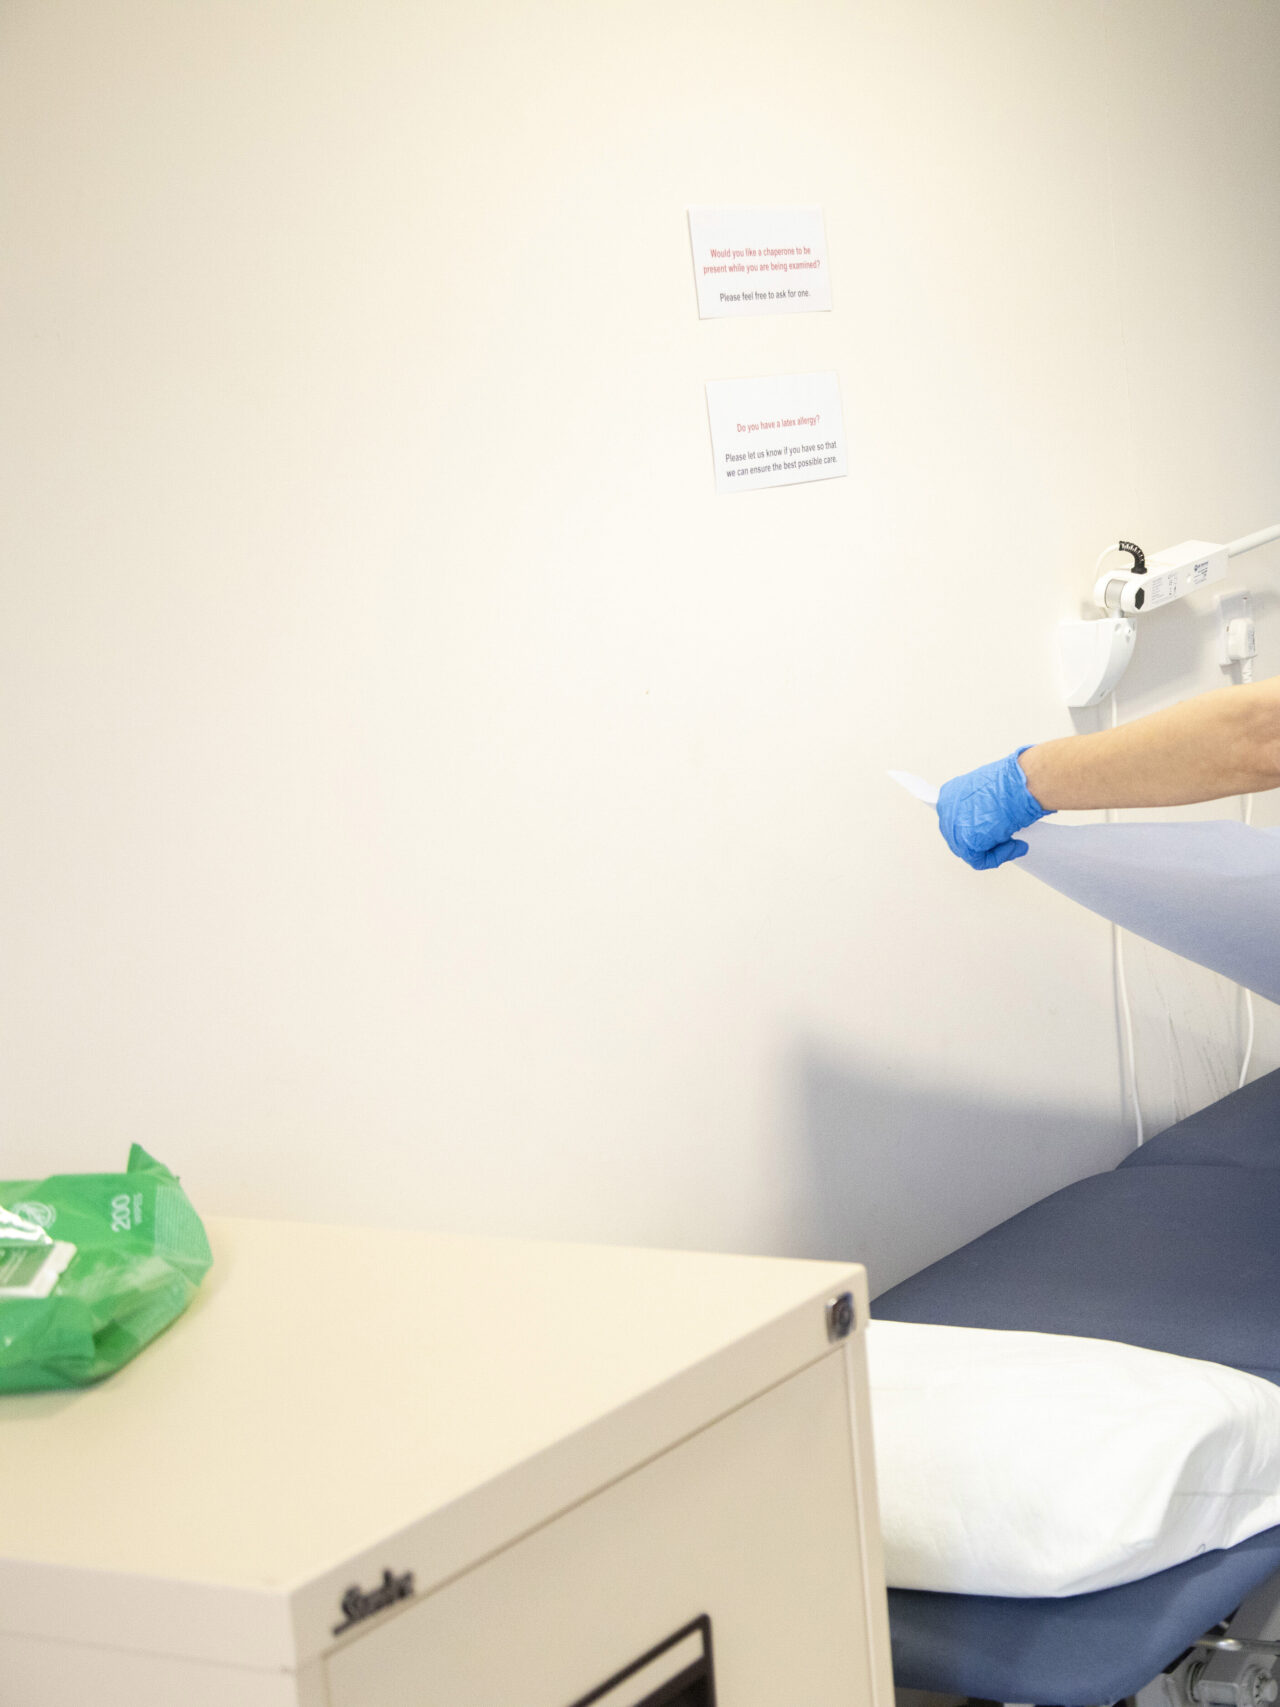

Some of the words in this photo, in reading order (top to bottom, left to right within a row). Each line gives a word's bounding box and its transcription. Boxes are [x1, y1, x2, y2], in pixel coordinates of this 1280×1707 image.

[710, 248, 731, 258] Would
[733, 249, 744, 259] you
[745, 247, 756, 257] like
[763, 247, 795, 258] chaperone
[703, 264, 727, 276] present
[728, 263, 745, 272] while
[747, 264, 758, 274] you
[771, 261, 788, 272] being
[789, 260, 820, 270] examined?
[720, 292, 741, 302] Please
[742, 291, 753, 301] feel
[755, 291, 767, 300] free
[776, 290, 787, 299] ask
[787, 289, 796, 298] for
[737, 423, 746, 433] Do
[747, 424, 759, 433] you
[760, 421, 775, 430] have
[782, 418, 796, 427] latex
[797, 414, 820, 427] allergy?
[725, 453, 746, 462] Please
[748, 451, 756, 460] let
[757, 451, 765, 459] us
[766, 448, 782, 457] know
[789, 446, 801, 456] you
[801, 444, 816, 453] have
[816, 443, 824, 451] so
[825, 441, 837, 450] that
[726, 469, 736, 477] we
[737, 468, 749, 476] can
[750, 465, 771, 474] ensure
[772, 463, 782, 471] the
[783, 460, 797, 470] best
[797, 456, 823, 469] possible
[824, 455, 838, 464] care.
[111, 1194, 131, 1232] 200
